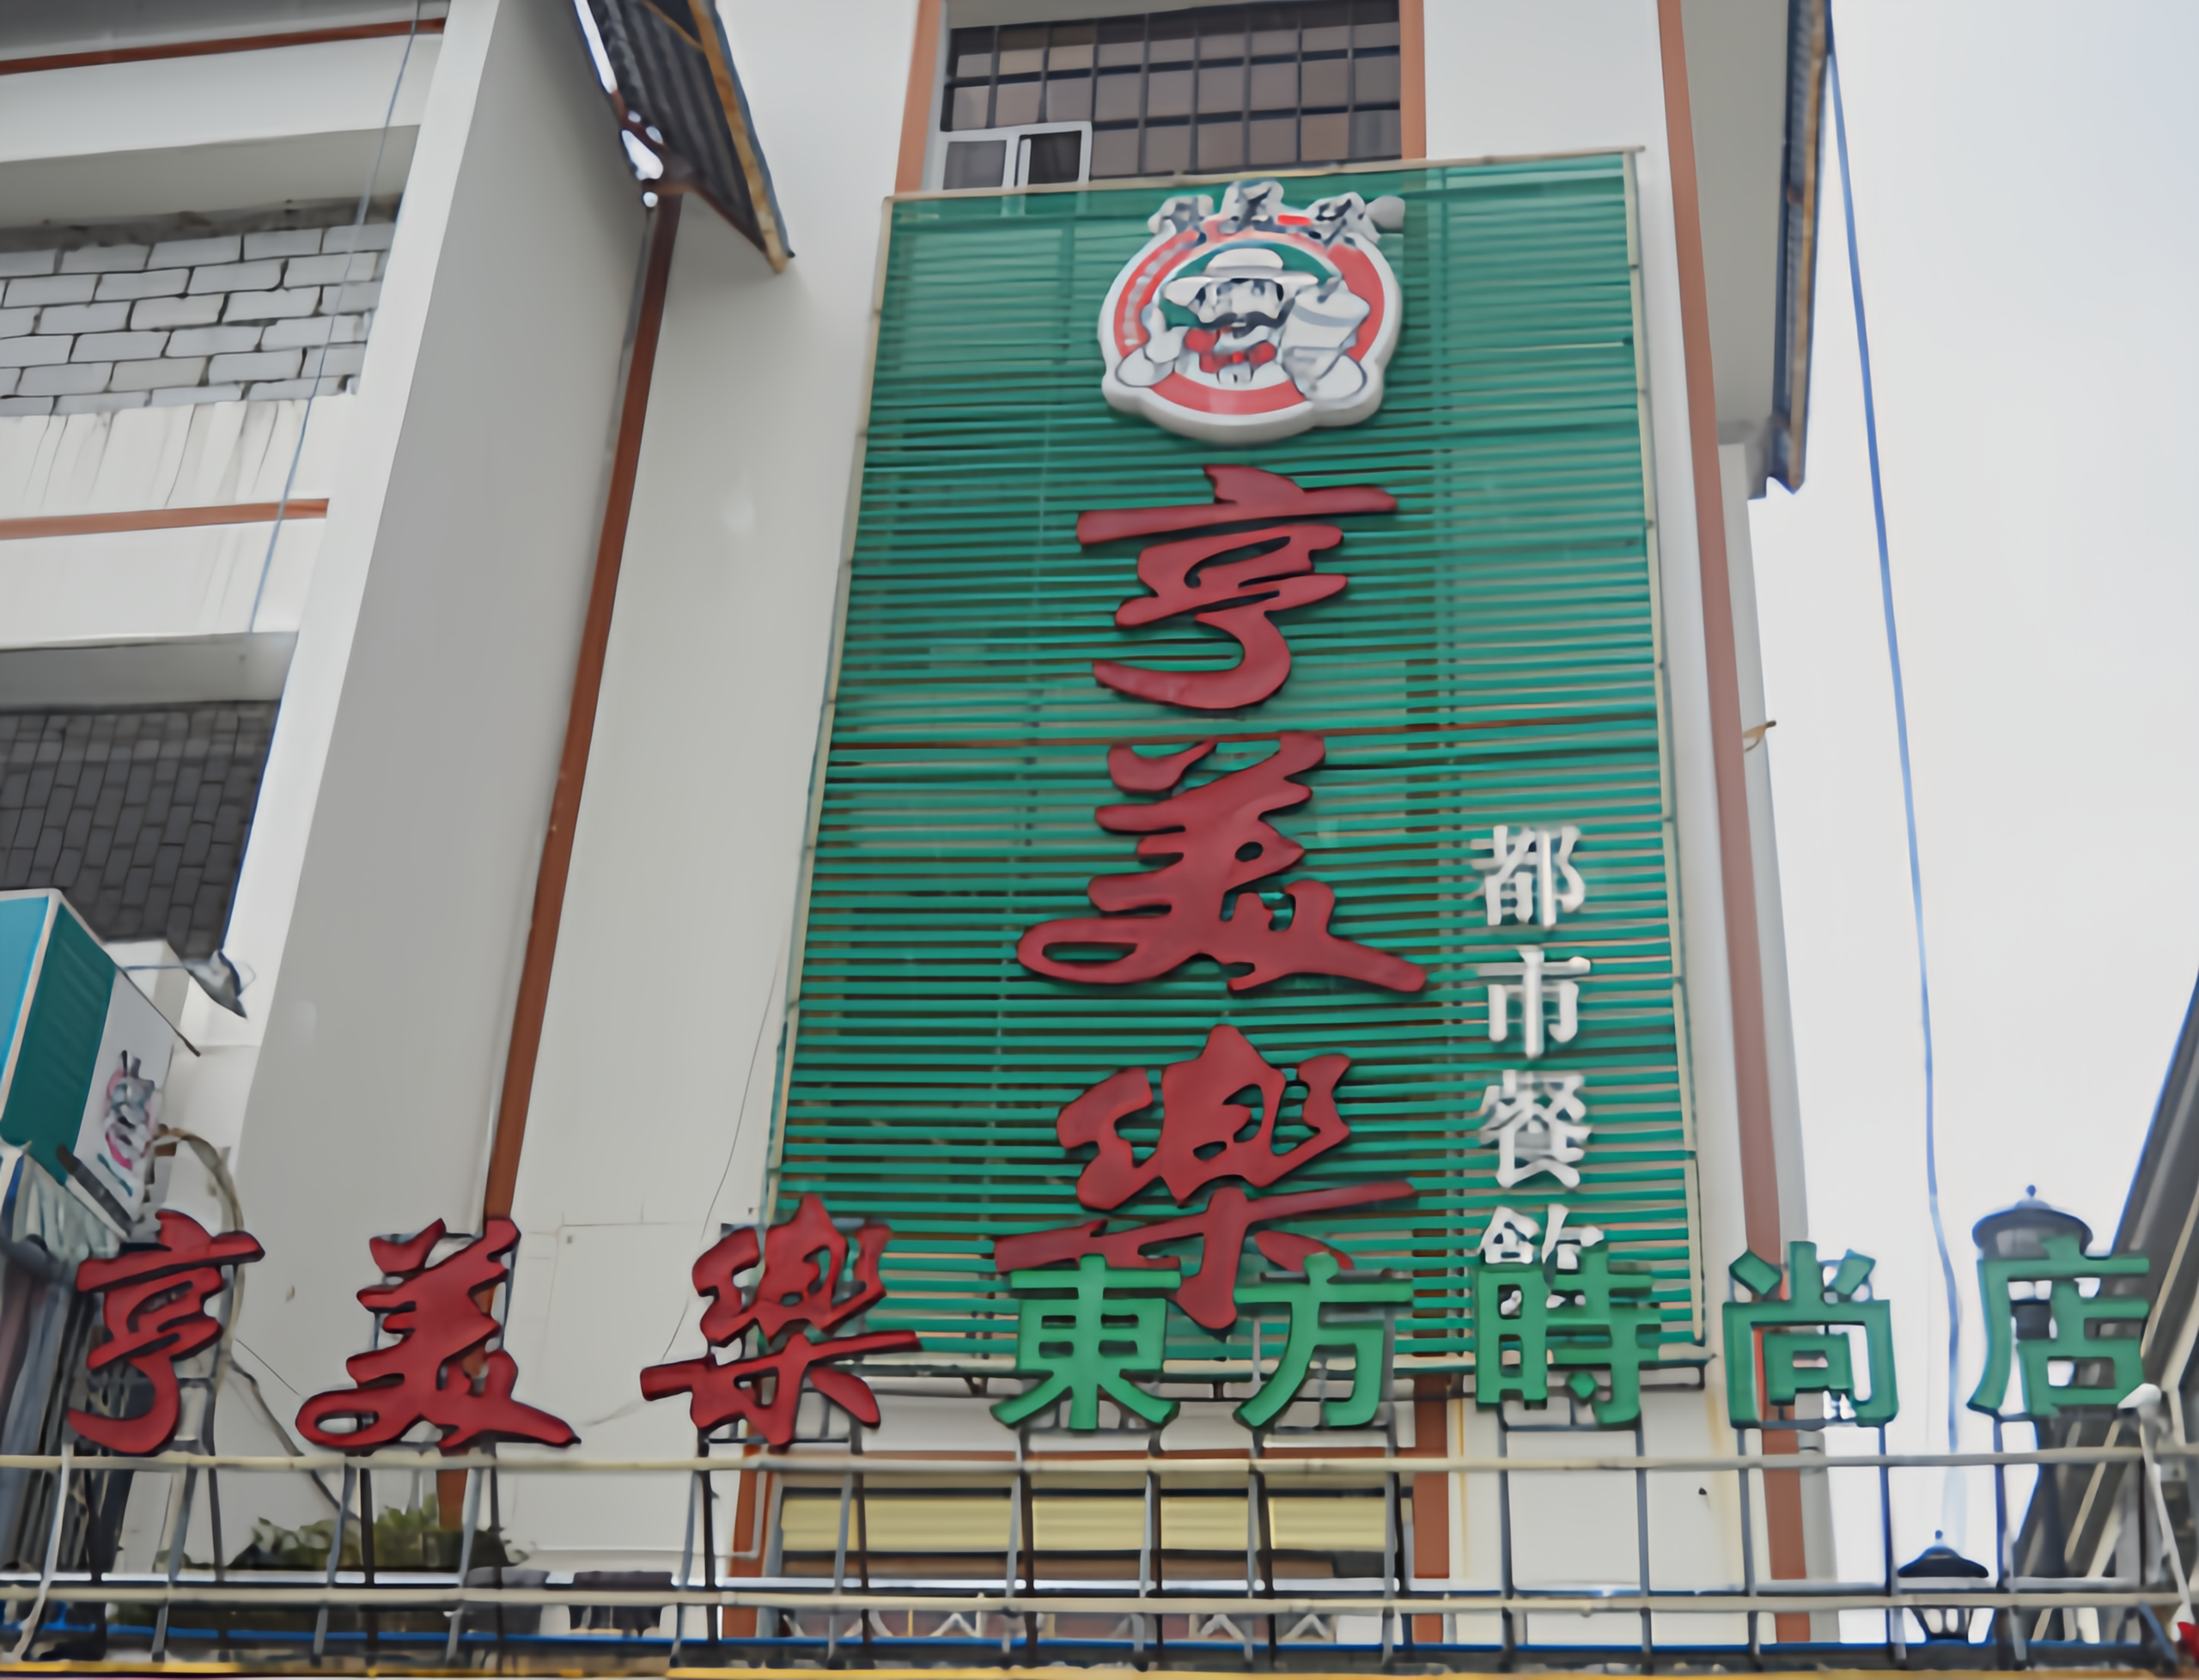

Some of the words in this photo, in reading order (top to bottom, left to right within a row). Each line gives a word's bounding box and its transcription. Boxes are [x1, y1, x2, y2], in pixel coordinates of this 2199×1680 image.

[990, 1235, 2149, 1430] 東方時尚店
